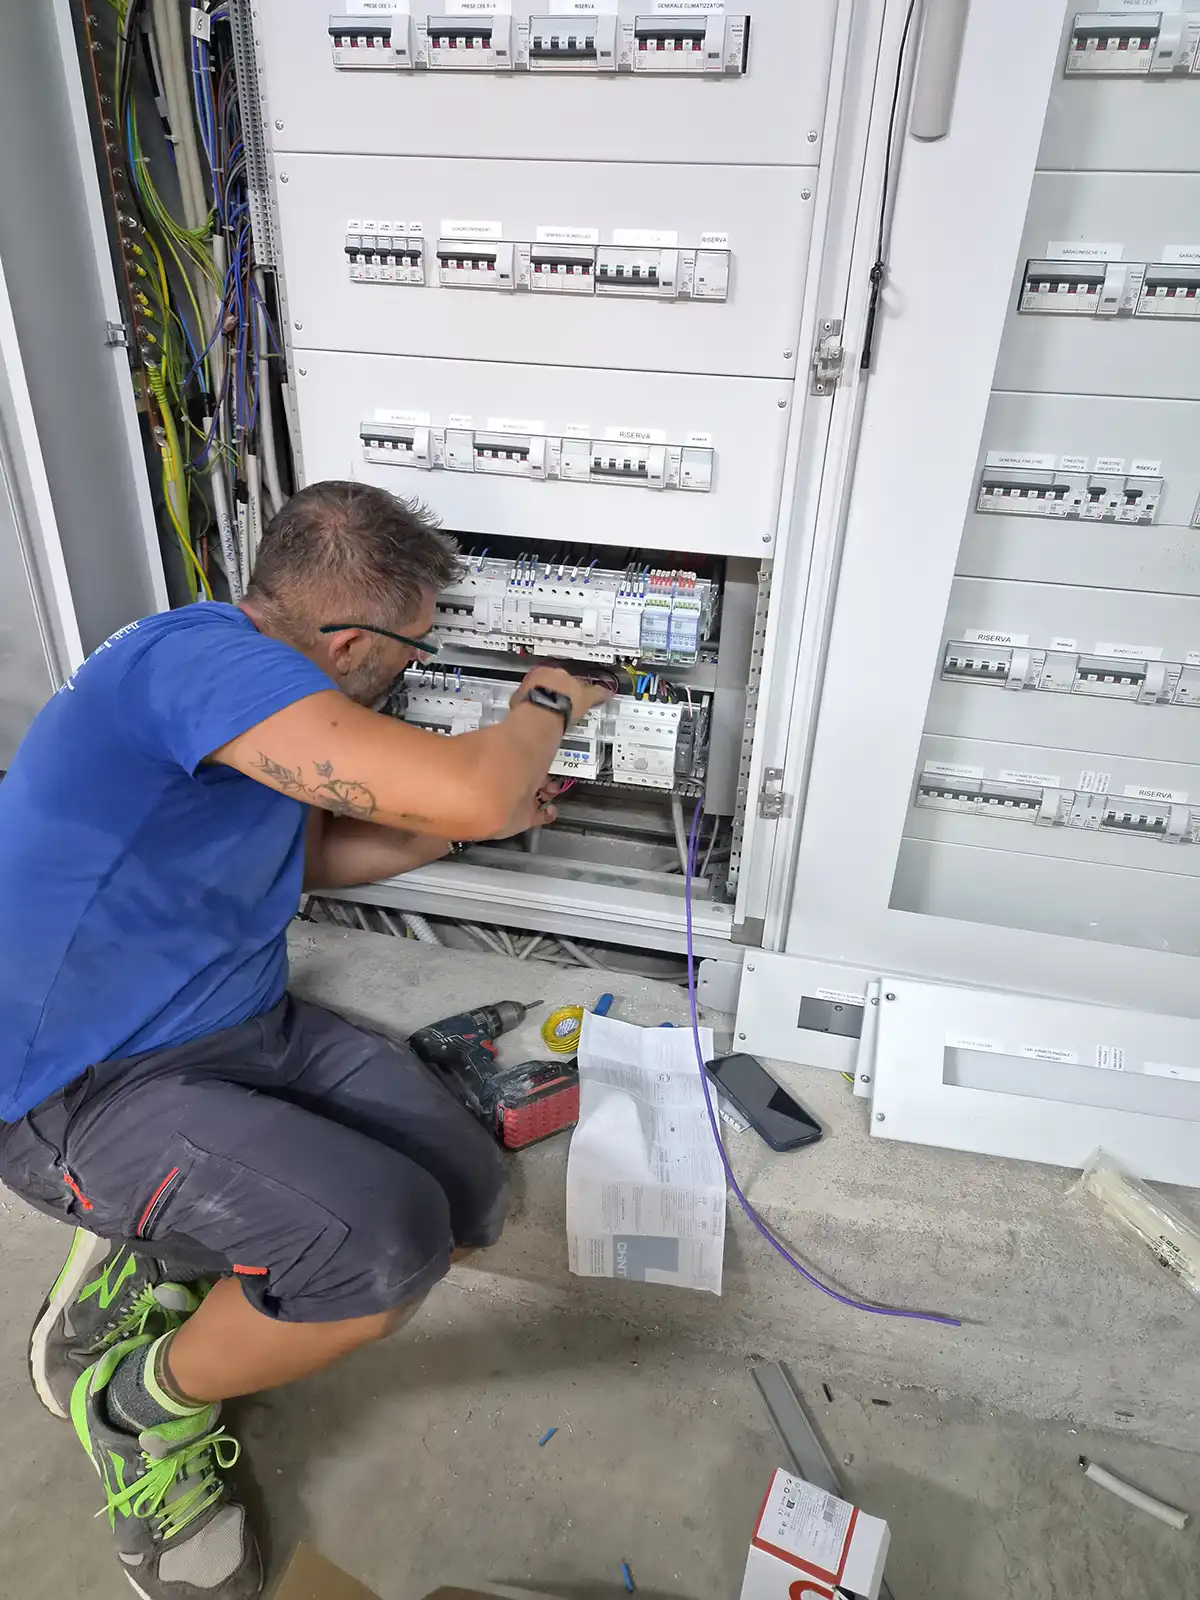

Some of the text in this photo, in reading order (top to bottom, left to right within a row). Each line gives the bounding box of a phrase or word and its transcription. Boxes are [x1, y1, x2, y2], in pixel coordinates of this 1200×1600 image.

[619, 431, 652, 440] RISERVA
[1136, 464, 1158, 472] RISERVA
[977, 633, 1012, 643] RISERVA
[563, 761, 580, 769] FOX
[1138, 789, 1173, 800] RISERVA
